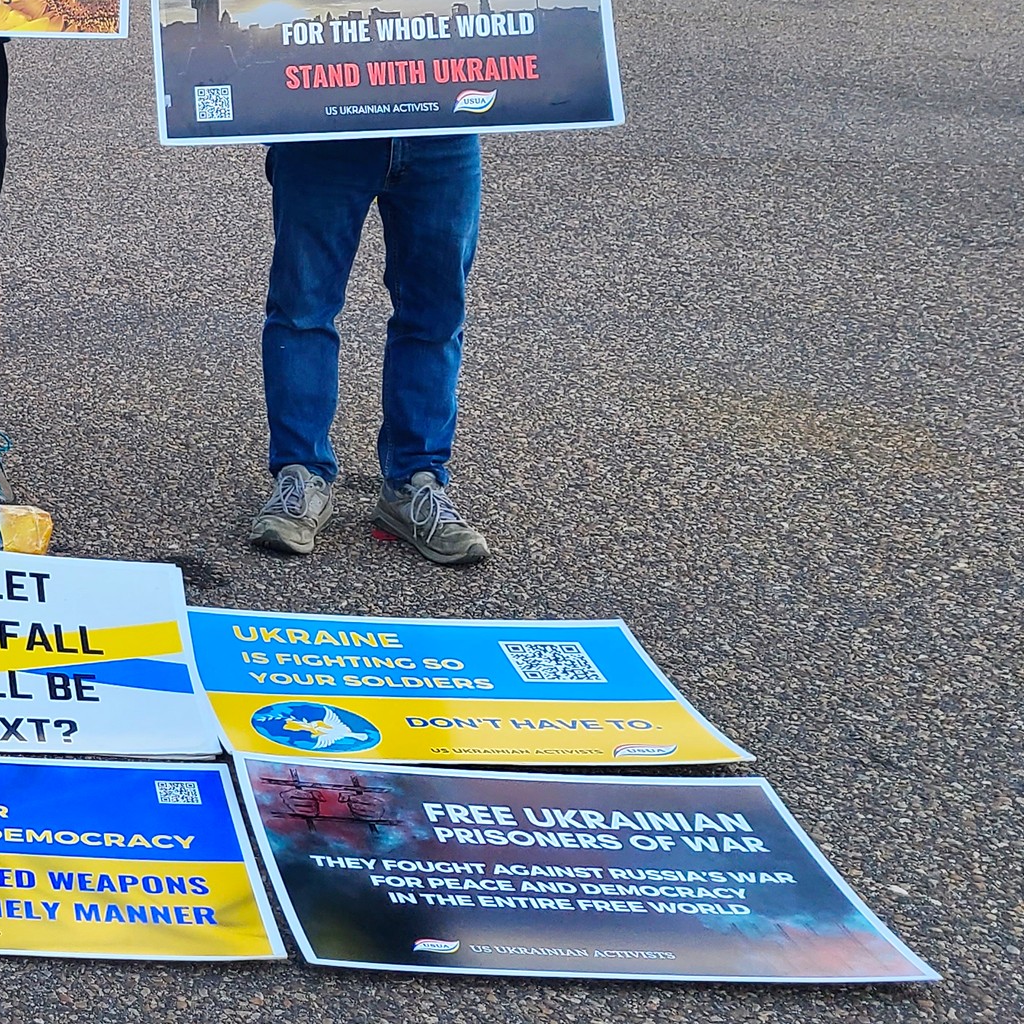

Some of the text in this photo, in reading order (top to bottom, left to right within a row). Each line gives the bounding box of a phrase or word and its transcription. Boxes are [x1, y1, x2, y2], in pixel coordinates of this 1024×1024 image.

[282, 11, 536, 46] FOR THE WHOLE WORLD
[285, 55, 540, 89] STAND WITH UKRAINE
[325, 102, 440, 116] US UKRAINIAN ACTIVISTS
[463, 96, 486, 106] USUA
[232, 625, 404, 649] UKRAINE
[241, 651, 464, 671] IS FIGHTING SO
[47, 671, 100, 703] BE
[249, 671, 495, 690] YOUR SOLDIERS
[404, 716, 663, 731] DON'T HAVE TO.
[422, 802, 753, 832] FREE UKRAINIAN
[433, 826, 771, 854] PRISONERS OF WAR
[310, 855, 798, 885] THEY FOUGHT AGAINST RUSSIA'S WAR
[47, 872, 211, 896] WEAPONS
[370, 875, 747, 900] FOR PEACE AND DEMOCRACY
[73, 904, 217, 926] MANNER
[389, 890, 751, 916] IN THE ENTIRE FREE WORLD
[469, 944, 676, 960] US UKRAINIAN ACTIVISTS
